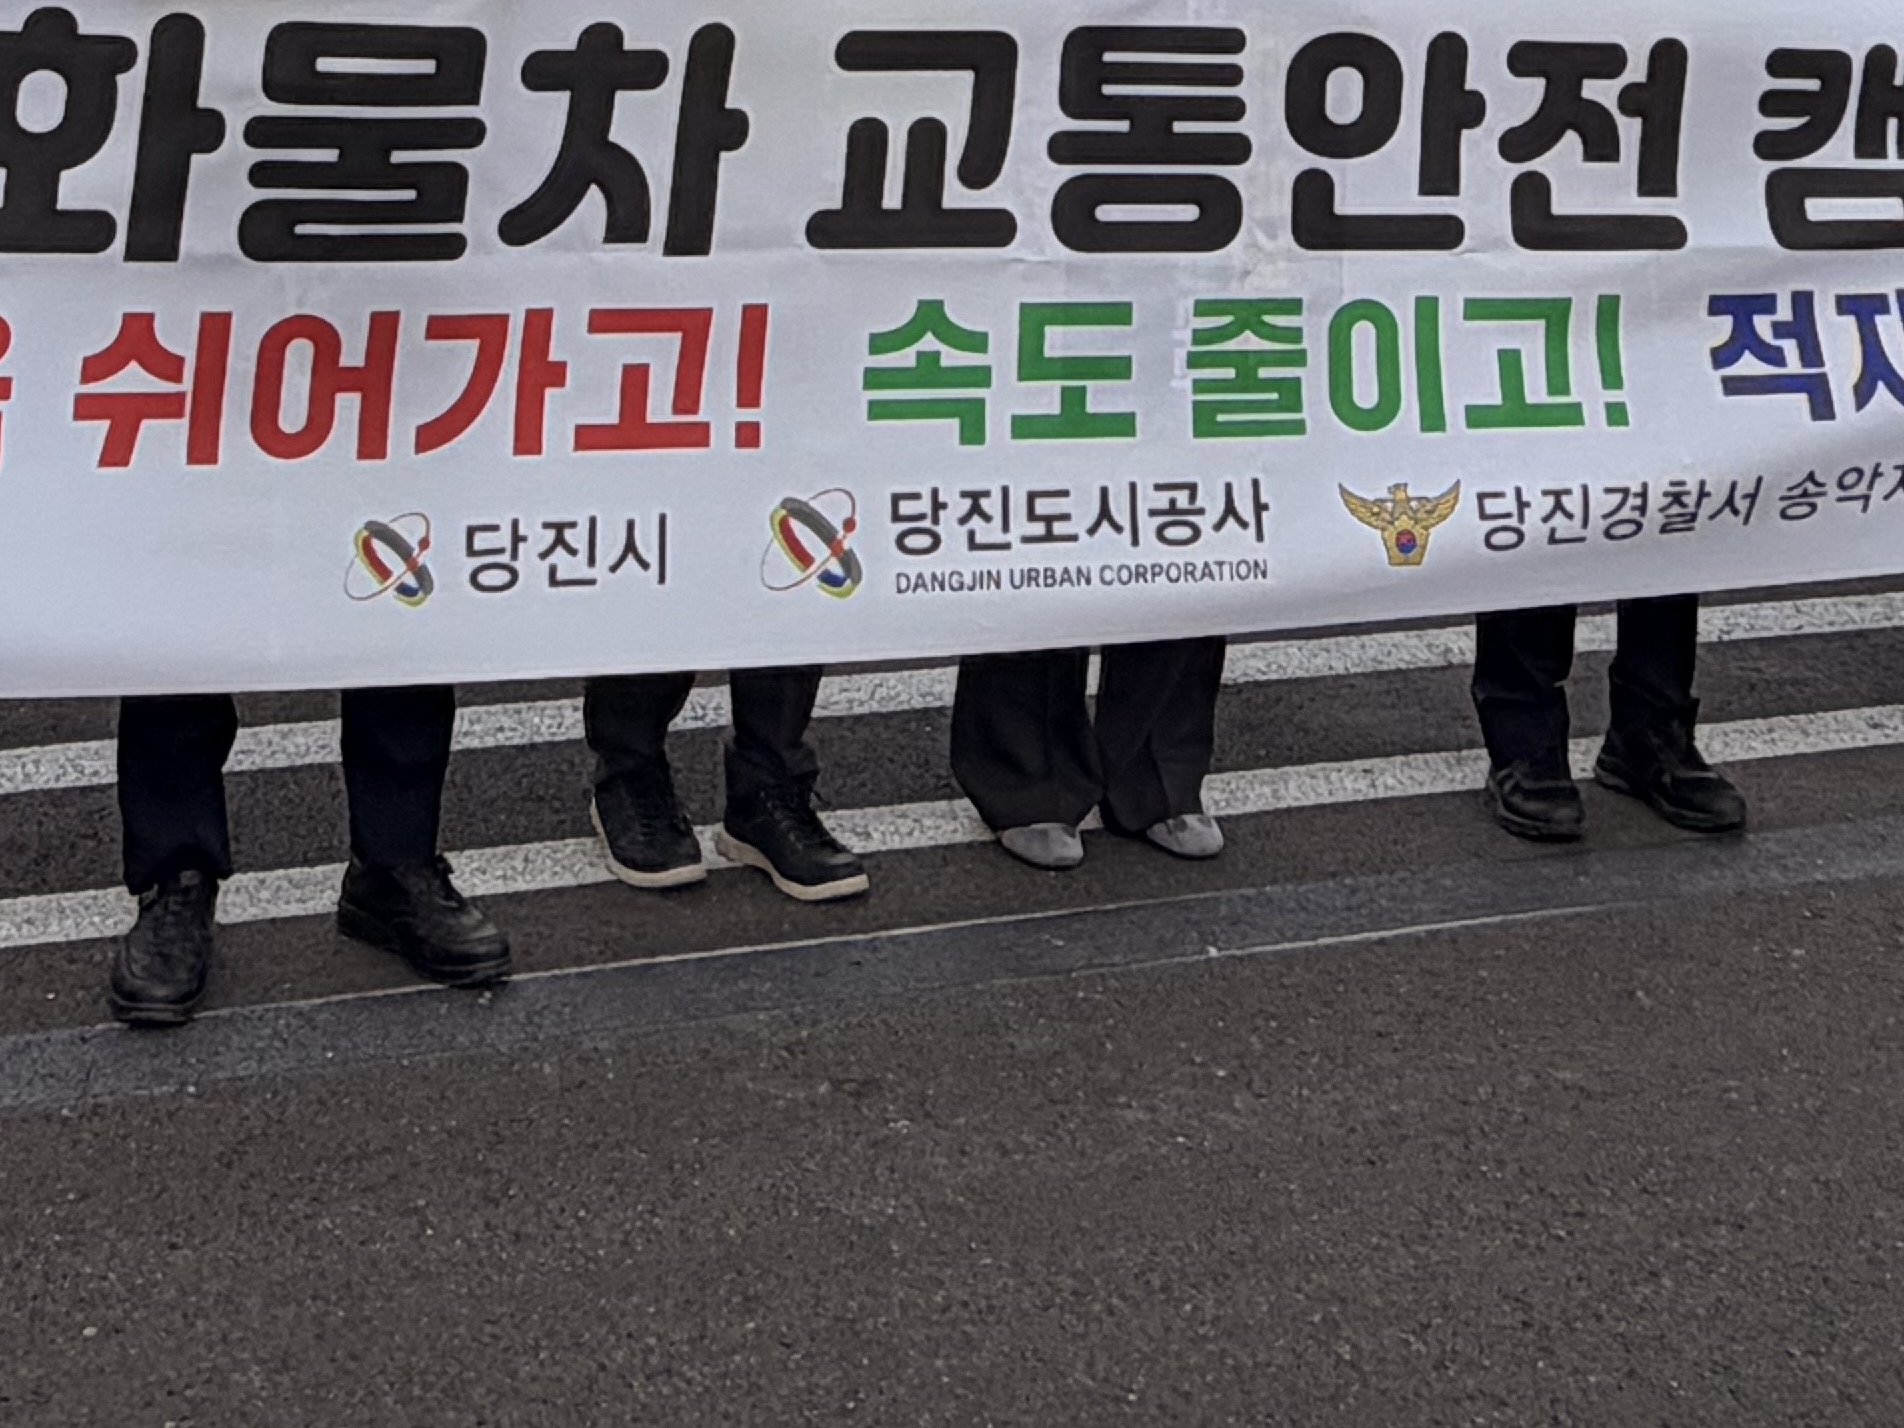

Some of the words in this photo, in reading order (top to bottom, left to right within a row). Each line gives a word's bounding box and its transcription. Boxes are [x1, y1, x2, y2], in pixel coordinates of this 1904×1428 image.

[804, 23, 1691, 254] 교통안전
[71, 302, 770, 471] 쉬어가고!
[861, 297, 1140, 447] 속도
[1185, 292, 1630, 440] 줄이고!
[464, 511, 671, 594] 당진시
[890, 477, 1272, 554] 당진도시공사
[1475, 475, 1764, 551] 당진경찰서
[894, 566, 1002, 595] DANGJIN
[1009, 563, 1094, 591] URBAN
[1100, 558, 1268, 588] CORPORATION
